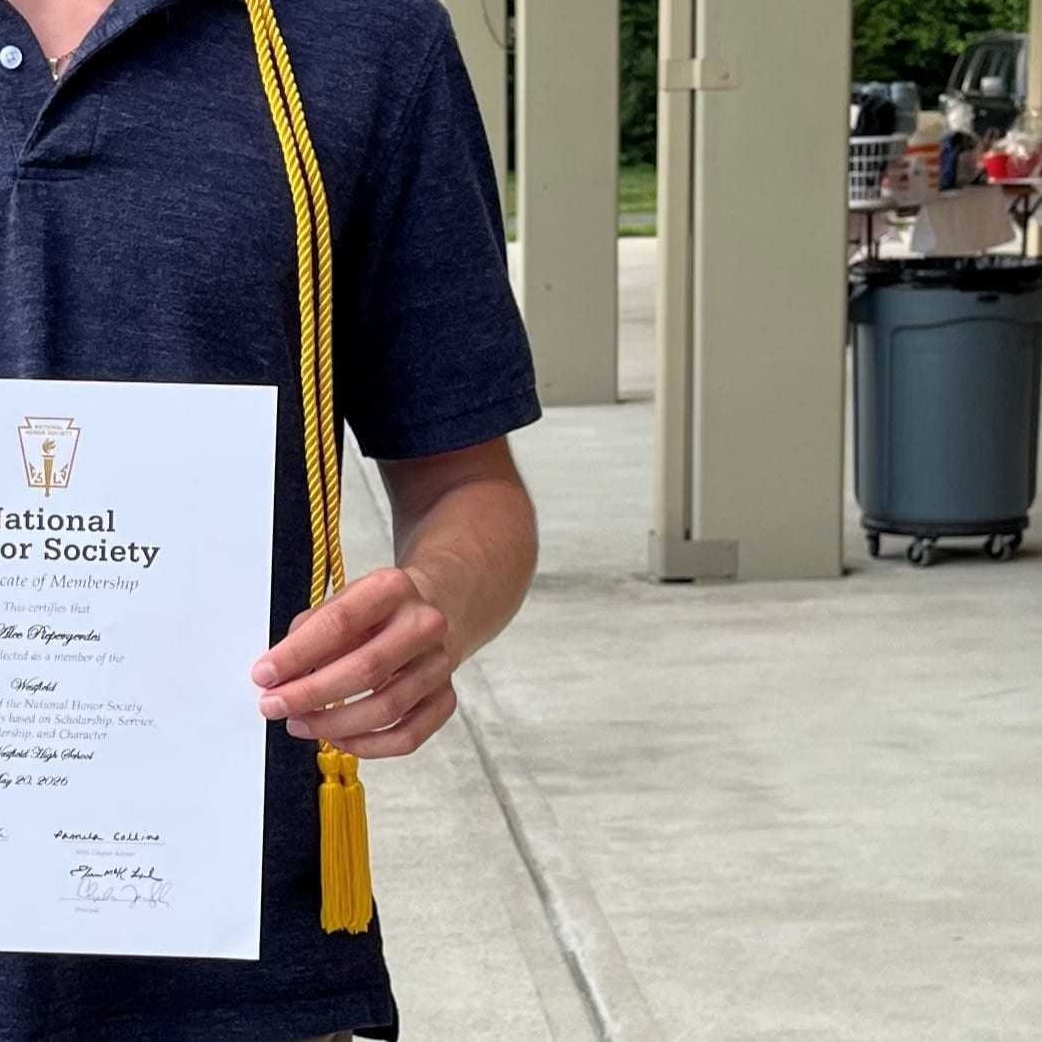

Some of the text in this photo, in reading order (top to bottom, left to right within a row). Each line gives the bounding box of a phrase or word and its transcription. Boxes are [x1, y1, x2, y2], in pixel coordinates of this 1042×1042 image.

[43, 538, 160, 569] Society
[32, 573, 48, 592] of
[50, 574, 139, 594] Membership
[3, 601, 90, 616] This certifies that
[31, 653, 42, 661] as
[44, 653, 51, 661] a
[54, 652, 93, 663] member
[96, 652, 108, 666] of
[109, 652, 125, 664] the
[6, 698, 22, 710] the
[24, 699, 68, 711] National
[71, 700, 104, 712] Honor
[106, 701, 143, 715] Society
[9, 712, 35, 724] based
[38, 715, 51, 725] on
[36, 728, 57, 740] and
[30, 746, 59, 763] High
[61, 747, 94, 761] School
[36, 775, 69, 787] 2026
